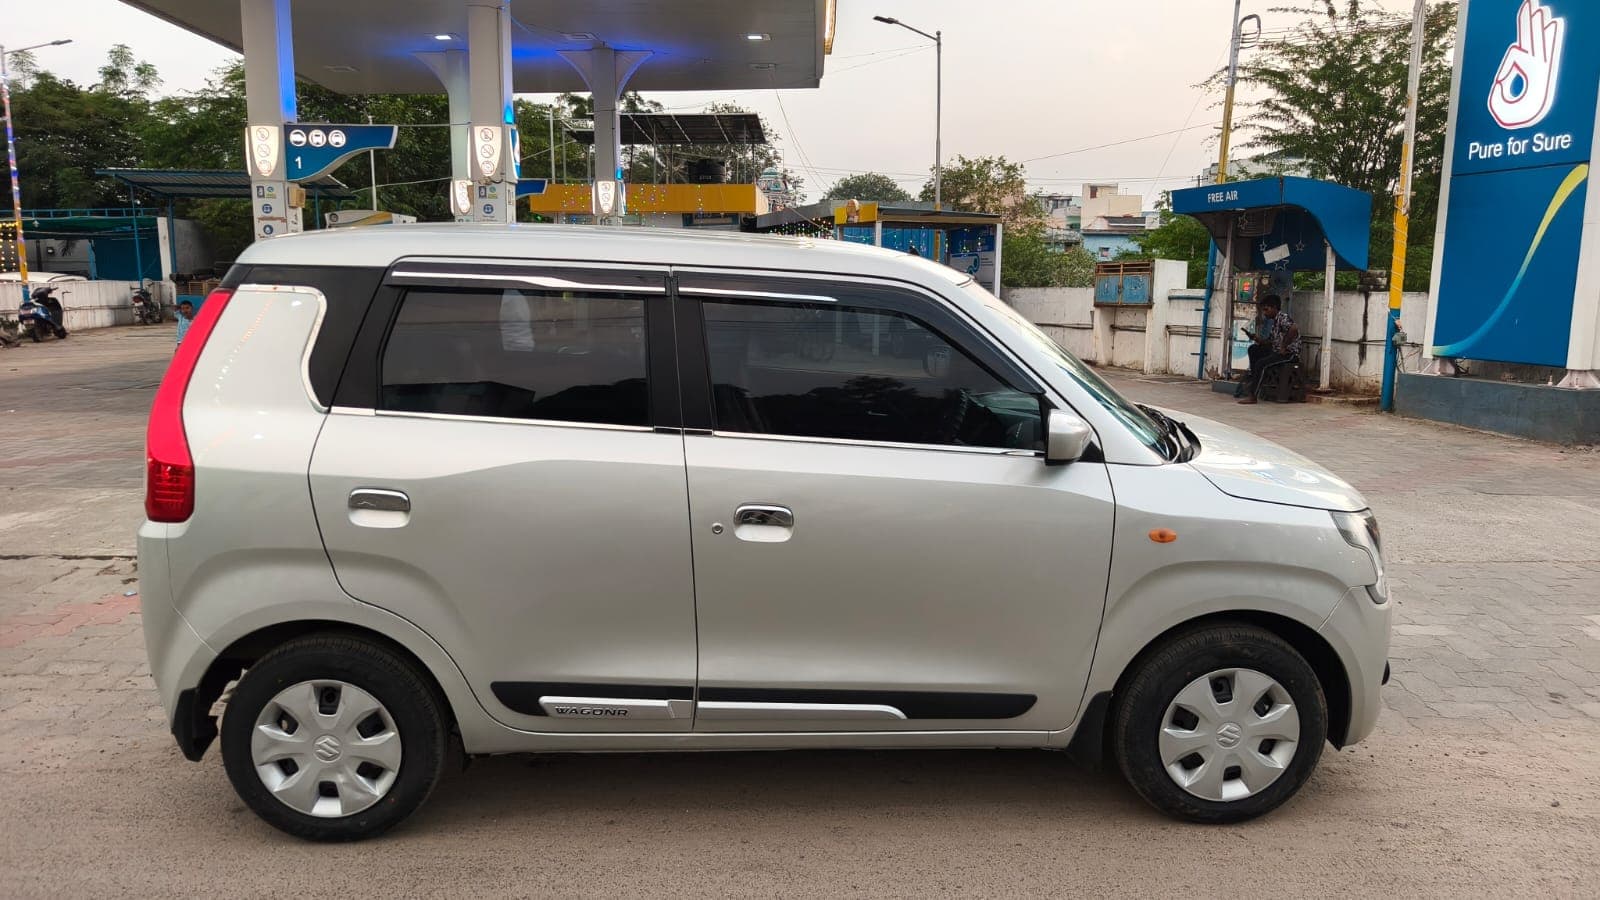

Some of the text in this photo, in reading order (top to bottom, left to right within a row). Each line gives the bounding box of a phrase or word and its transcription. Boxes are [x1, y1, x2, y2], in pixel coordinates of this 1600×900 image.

[1469, 133, 1571, 161] Pure for Sure
[295, 156, 302, 170] 1
[1207, 190, 1238, 203] FREE AIR
[554, 706, 629, 717] WAGONR
